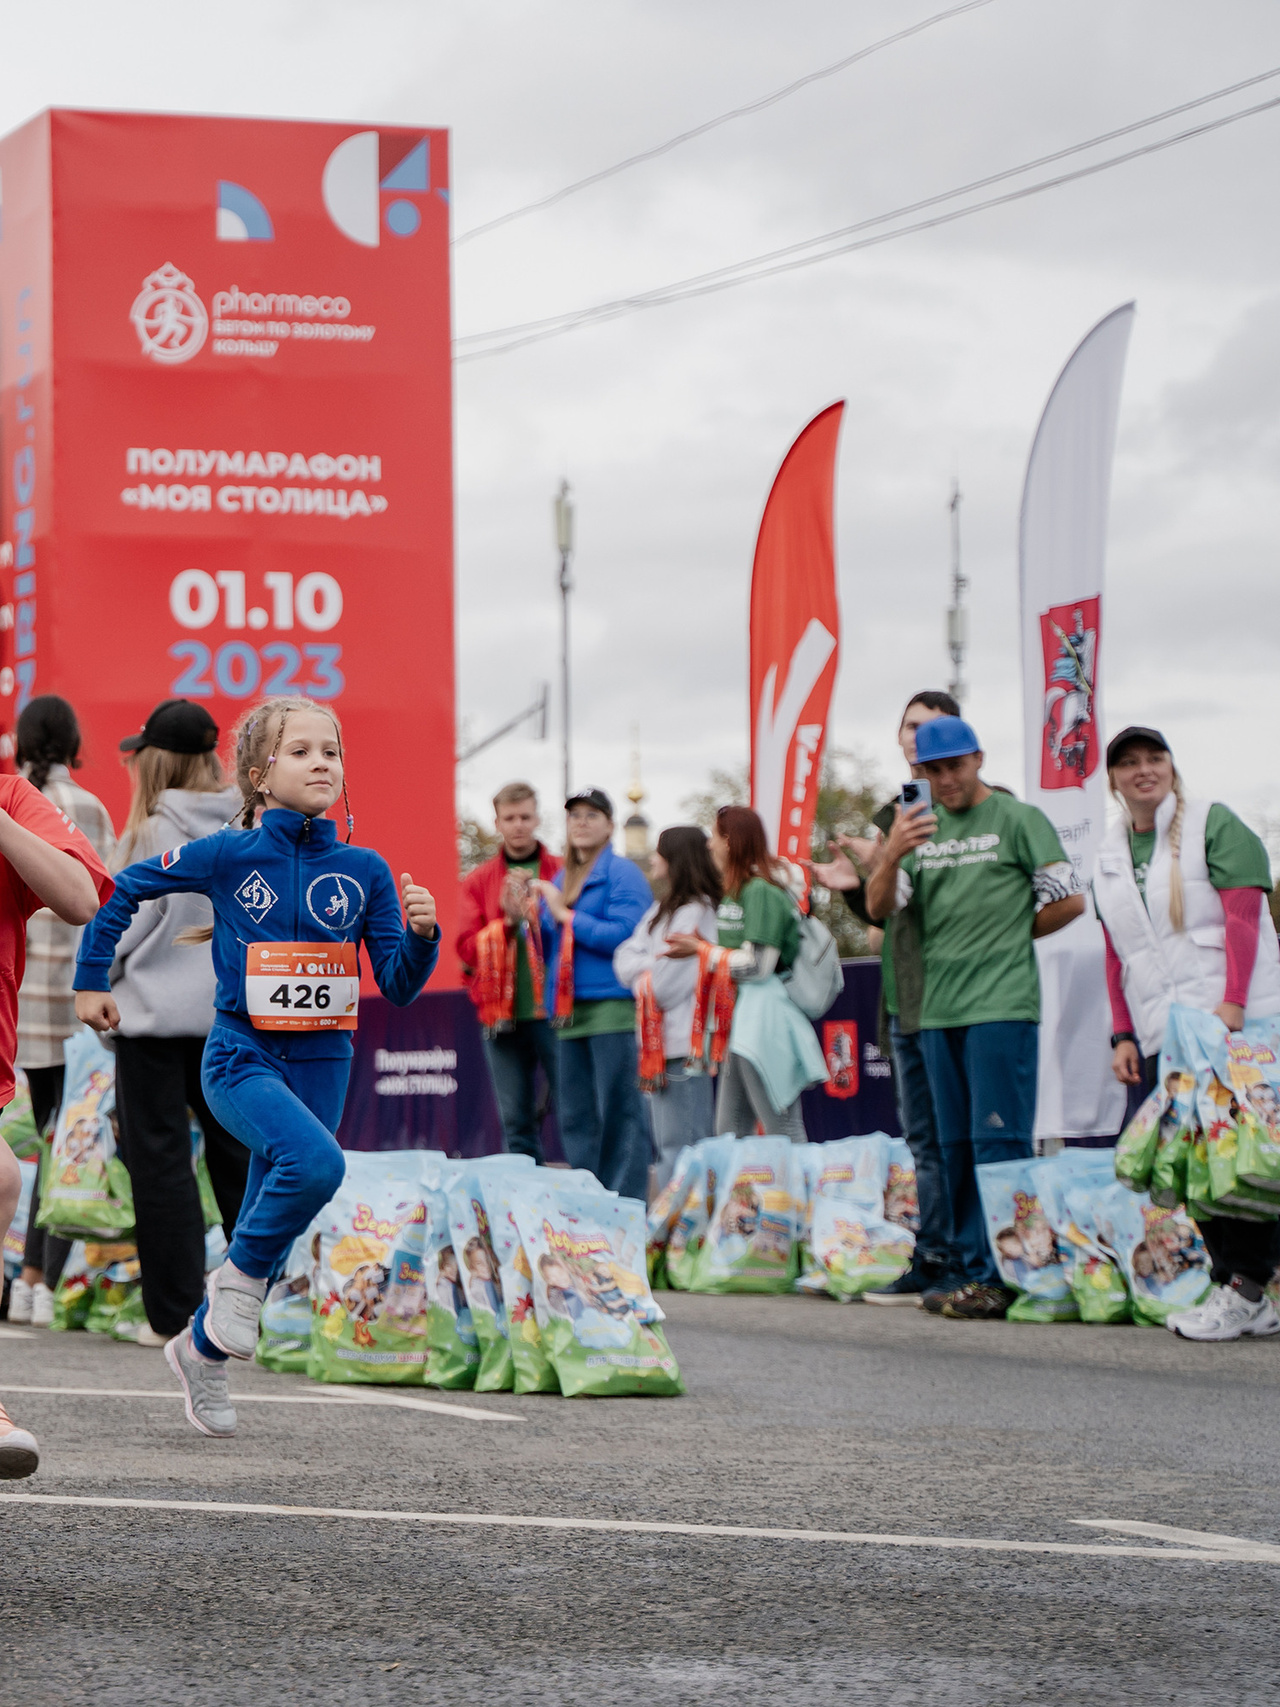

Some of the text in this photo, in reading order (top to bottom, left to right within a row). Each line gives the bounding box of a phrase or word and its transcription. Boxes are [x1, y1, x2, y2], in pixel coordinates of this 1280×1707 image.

[212, 285, 351, 318] pharmeco
[212, 339, 279, 358] КОЛЬЦУ
[267, 321, 291, 338] ПО
[292, 322, 376, 342] ЗОЛОТОМУ
[126, 447, 382, 482] ПОЛУМАРАФОН
[13, 284, 37, 718] NRING.run
[120, 483, 389, 520] «МОЯ СТОЛИЦА»
[169, 568, 344, 632] 01.10
[167, 639, 346, 699] 2023
[269, 984, 331, 1009] 426
[320, 1018, 332, 1026] 600
